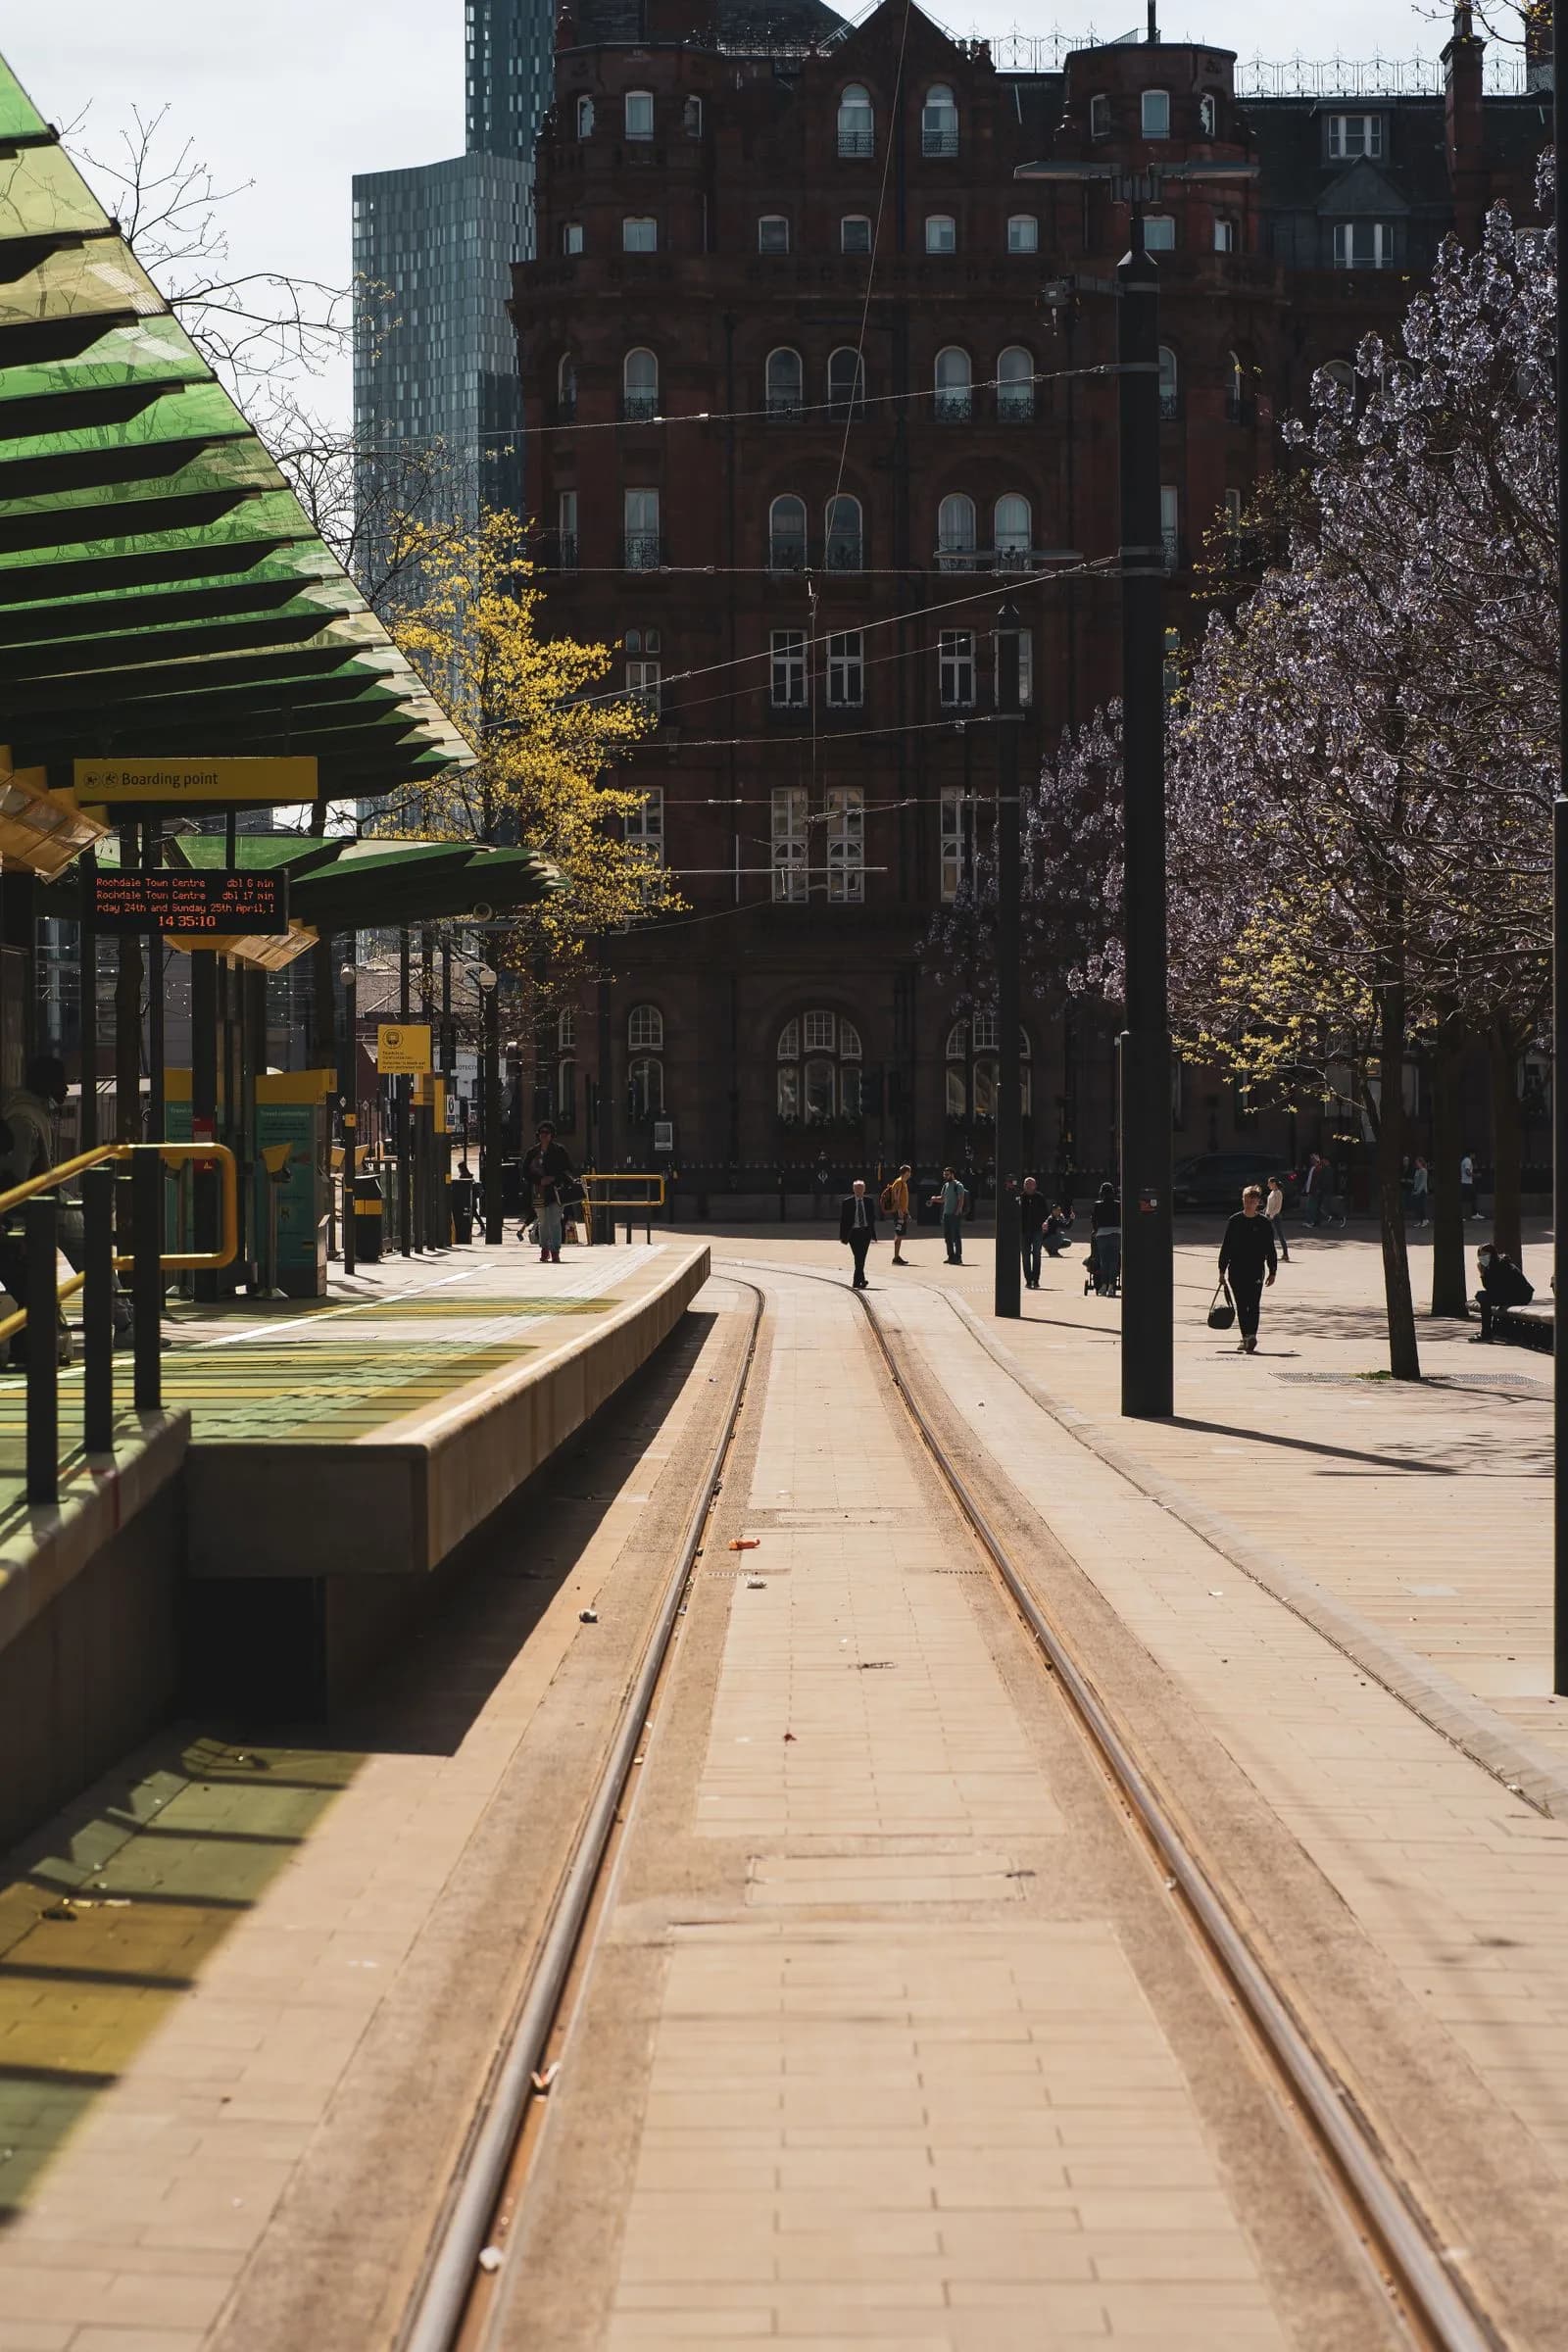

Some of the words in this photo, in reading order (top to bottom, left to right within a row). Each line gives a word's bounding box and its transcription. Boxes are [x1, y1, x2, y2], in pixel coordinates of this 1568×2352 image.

[122, 772, 181, 789] Boarding
[183, 772, 219, 789] point
[96, 877, 141, 887] Rochdale
[144, 877, 169, 887] Town
[172, 878, 206, 887] Centre
[257, 878, 274, 888] min
[96, 890, 141, 900] Rochdale
[144, 890, 169, 900] Town
[172, 890, 207, 900] Centre
[243, 891, 254, 901] 17
[257, 891, 274, 901] min
[123, 903, 147, 912] 24th
[150, 903, 169, 912] and
[172, 903, 207, 914] Sunday
[210, 903, 232, 912] 25th
